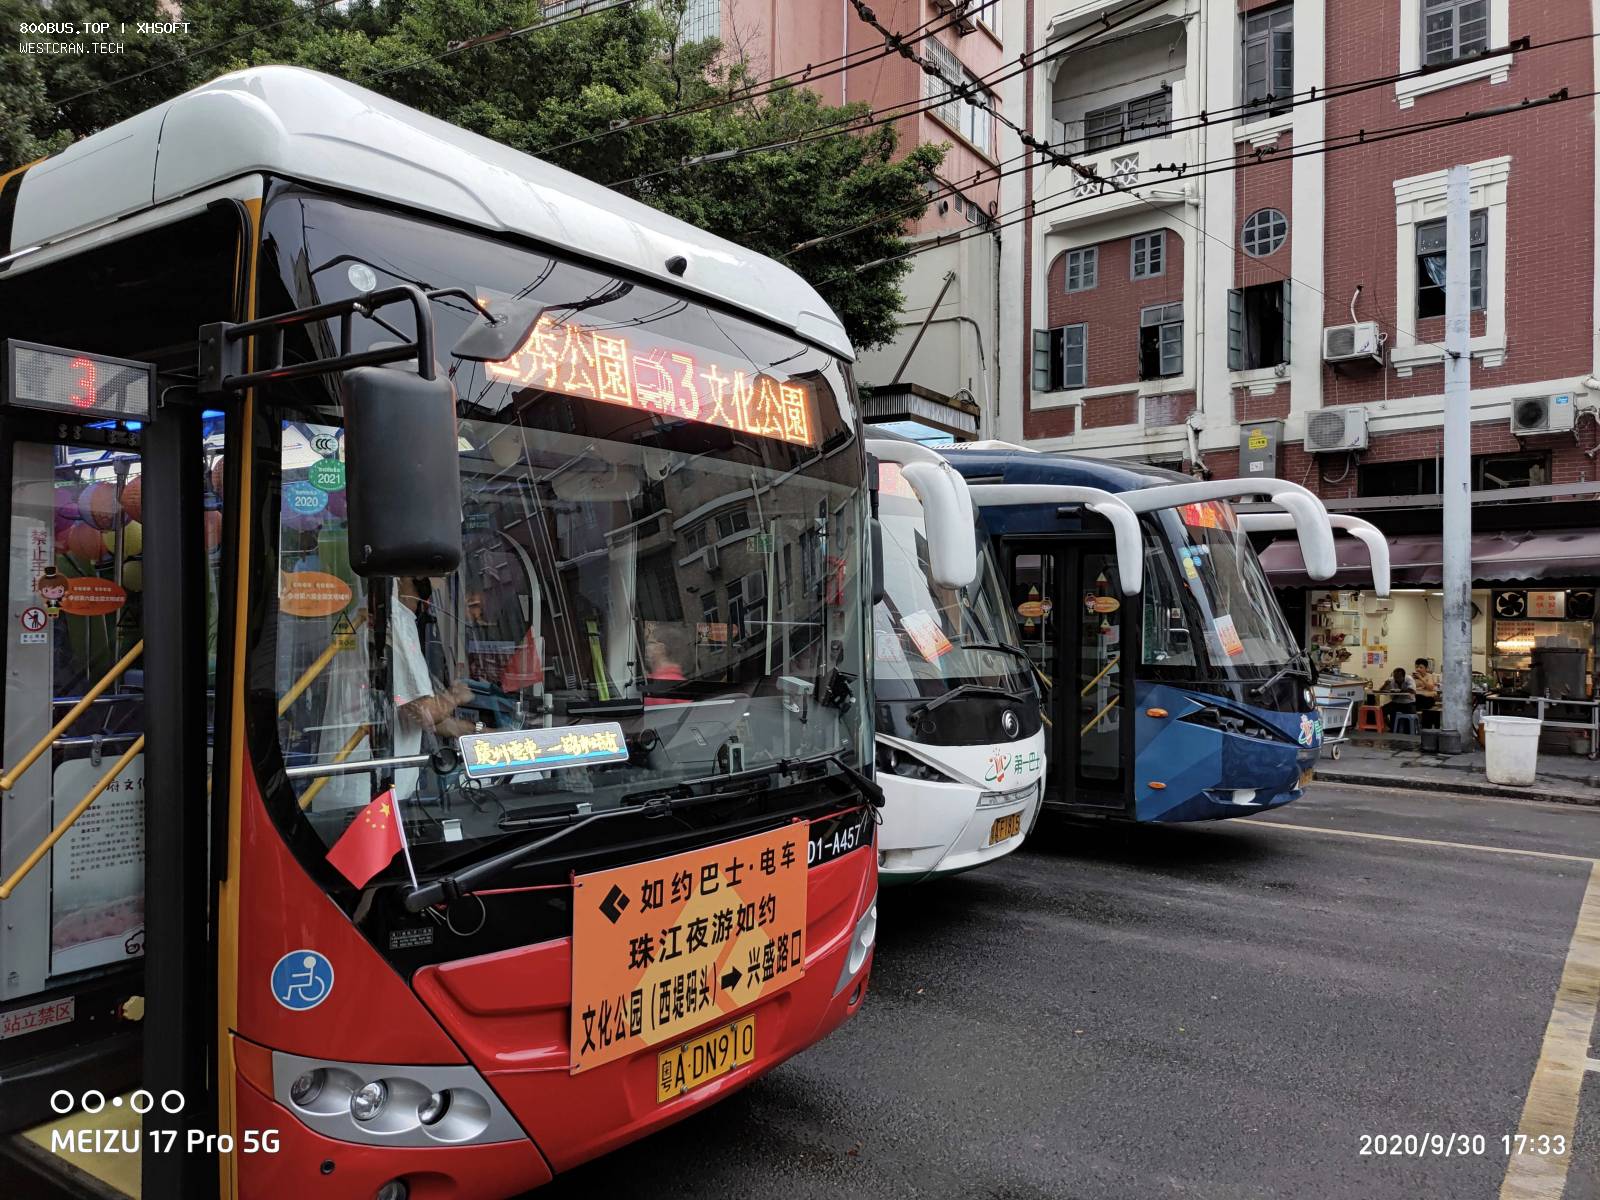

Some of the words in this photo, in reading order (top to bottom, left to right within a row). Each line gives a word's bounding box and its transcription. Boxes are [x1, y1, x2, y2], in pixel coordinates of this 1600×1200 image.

[70, 356, 97, 409] 3
[487, 317, 633, 406] 秀公園
[294, 496, 319, 507] 2020
[317, 473, 341, 484] 2021
[640, 841, 796, 914] 如约巴士·电车
[628, 893, 776, 971] 珠江夜游如约
[747, 929, 802, 990] 兴盛路口
[3, 1001, 71, 1033] 站立禁区
[661, 1024, 753, 1092] 粤A·DN910
